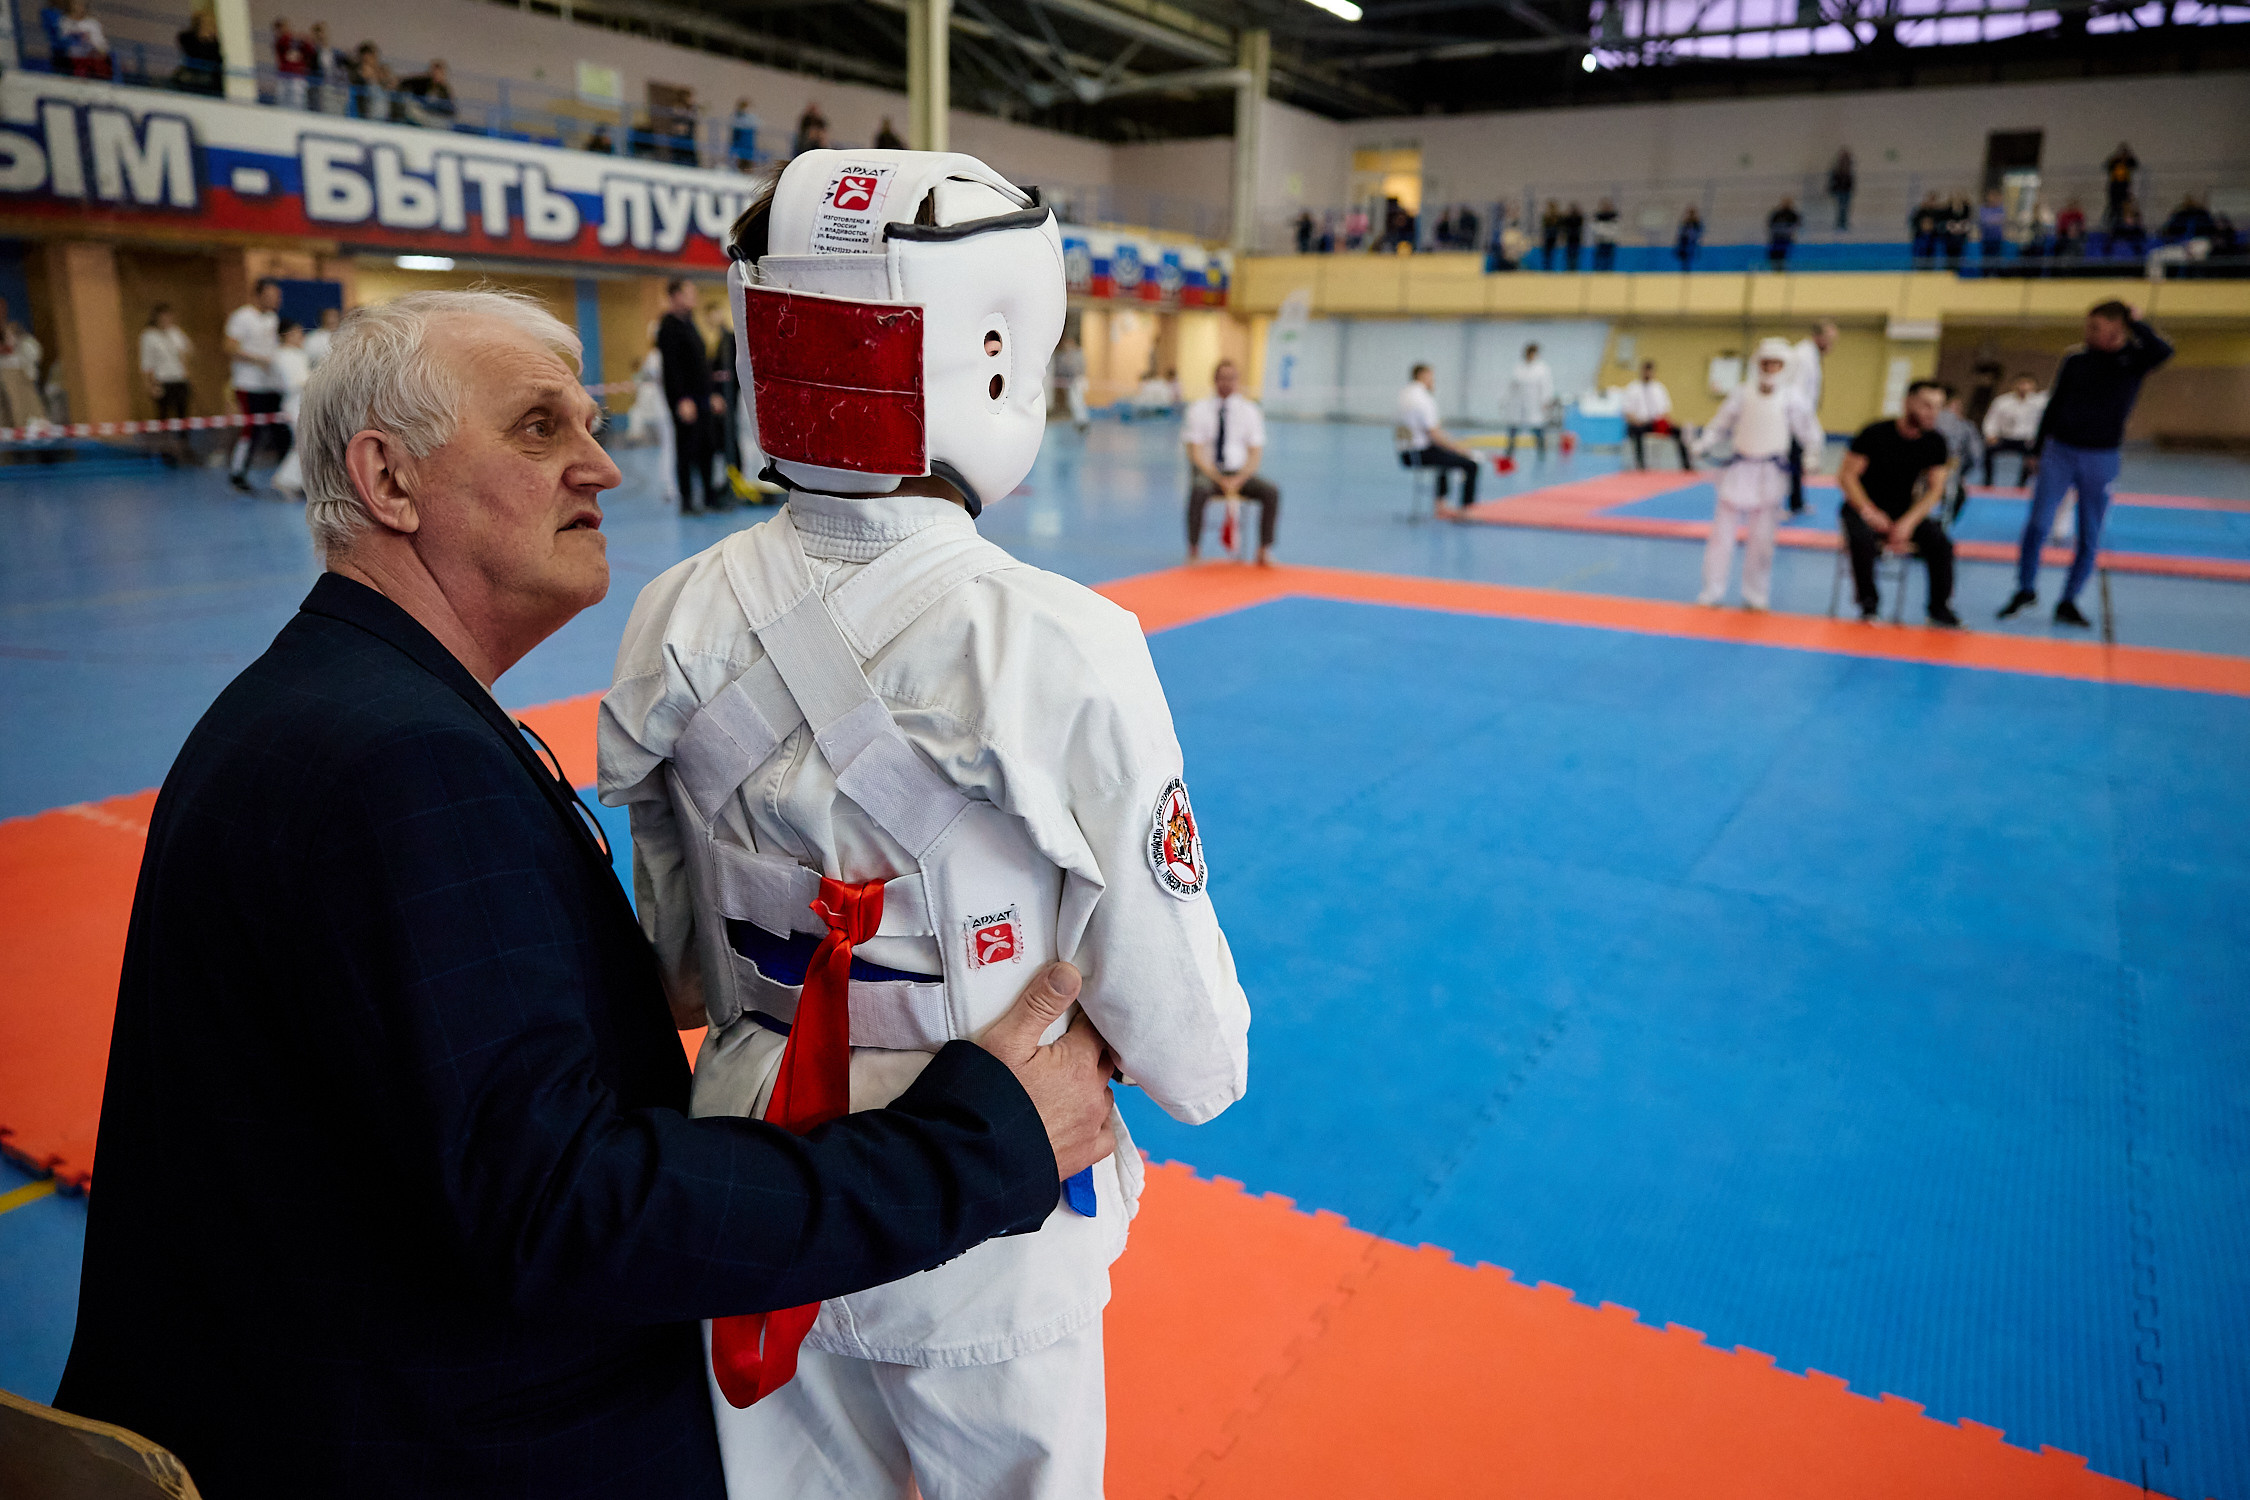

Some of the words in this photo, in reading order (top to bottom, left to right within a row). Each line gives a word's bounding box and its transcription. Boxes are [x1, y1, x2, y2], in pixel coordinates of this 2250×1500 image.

[841, 166, 889, 176] АРХАТ
[300, 134, 581, 243] БЫТЬ
[598, 178, 754, 257] ЛУЧ
[972, 910, 1012, 928] АРХАТ
